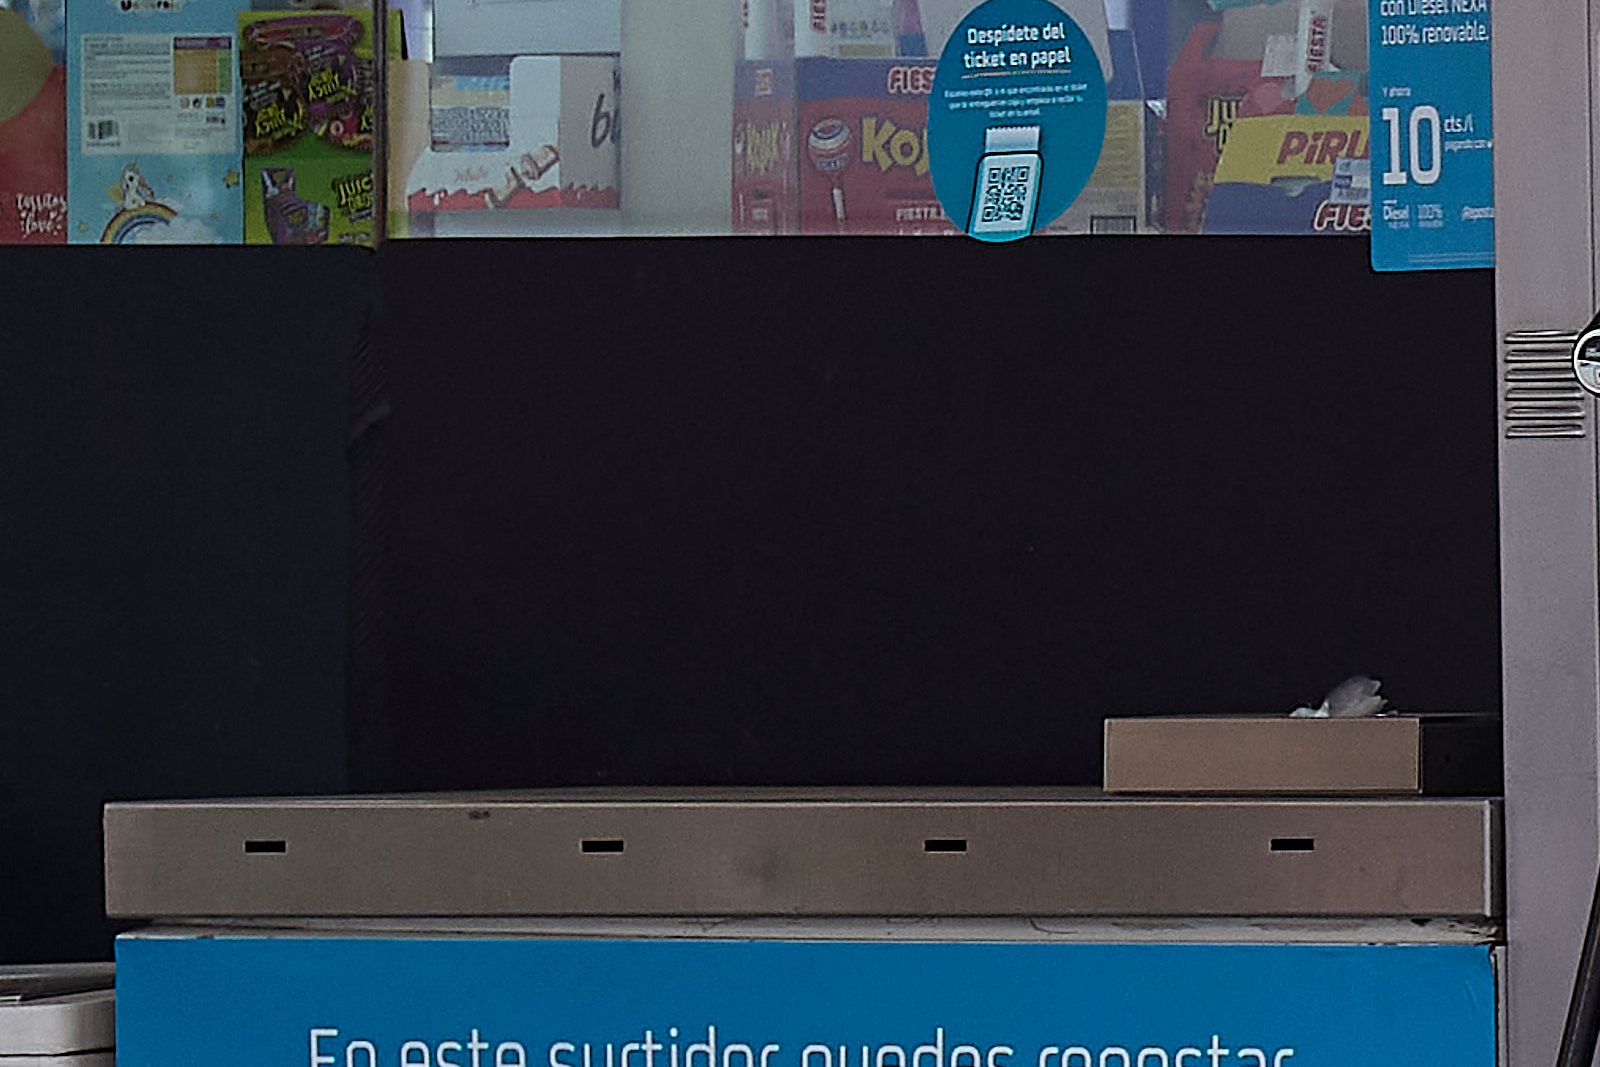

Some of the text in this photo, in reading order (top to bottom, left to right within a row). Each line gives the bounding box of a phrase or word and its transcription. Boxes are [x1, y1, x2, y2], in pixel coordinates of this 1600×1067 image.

[967, 22, 1066, 47] Despídete del
[1381, 24, 1421, 46] 100%
[963, 46, 1072, 69] ticket en papel
[1382, 105, 1442, 185] 10
